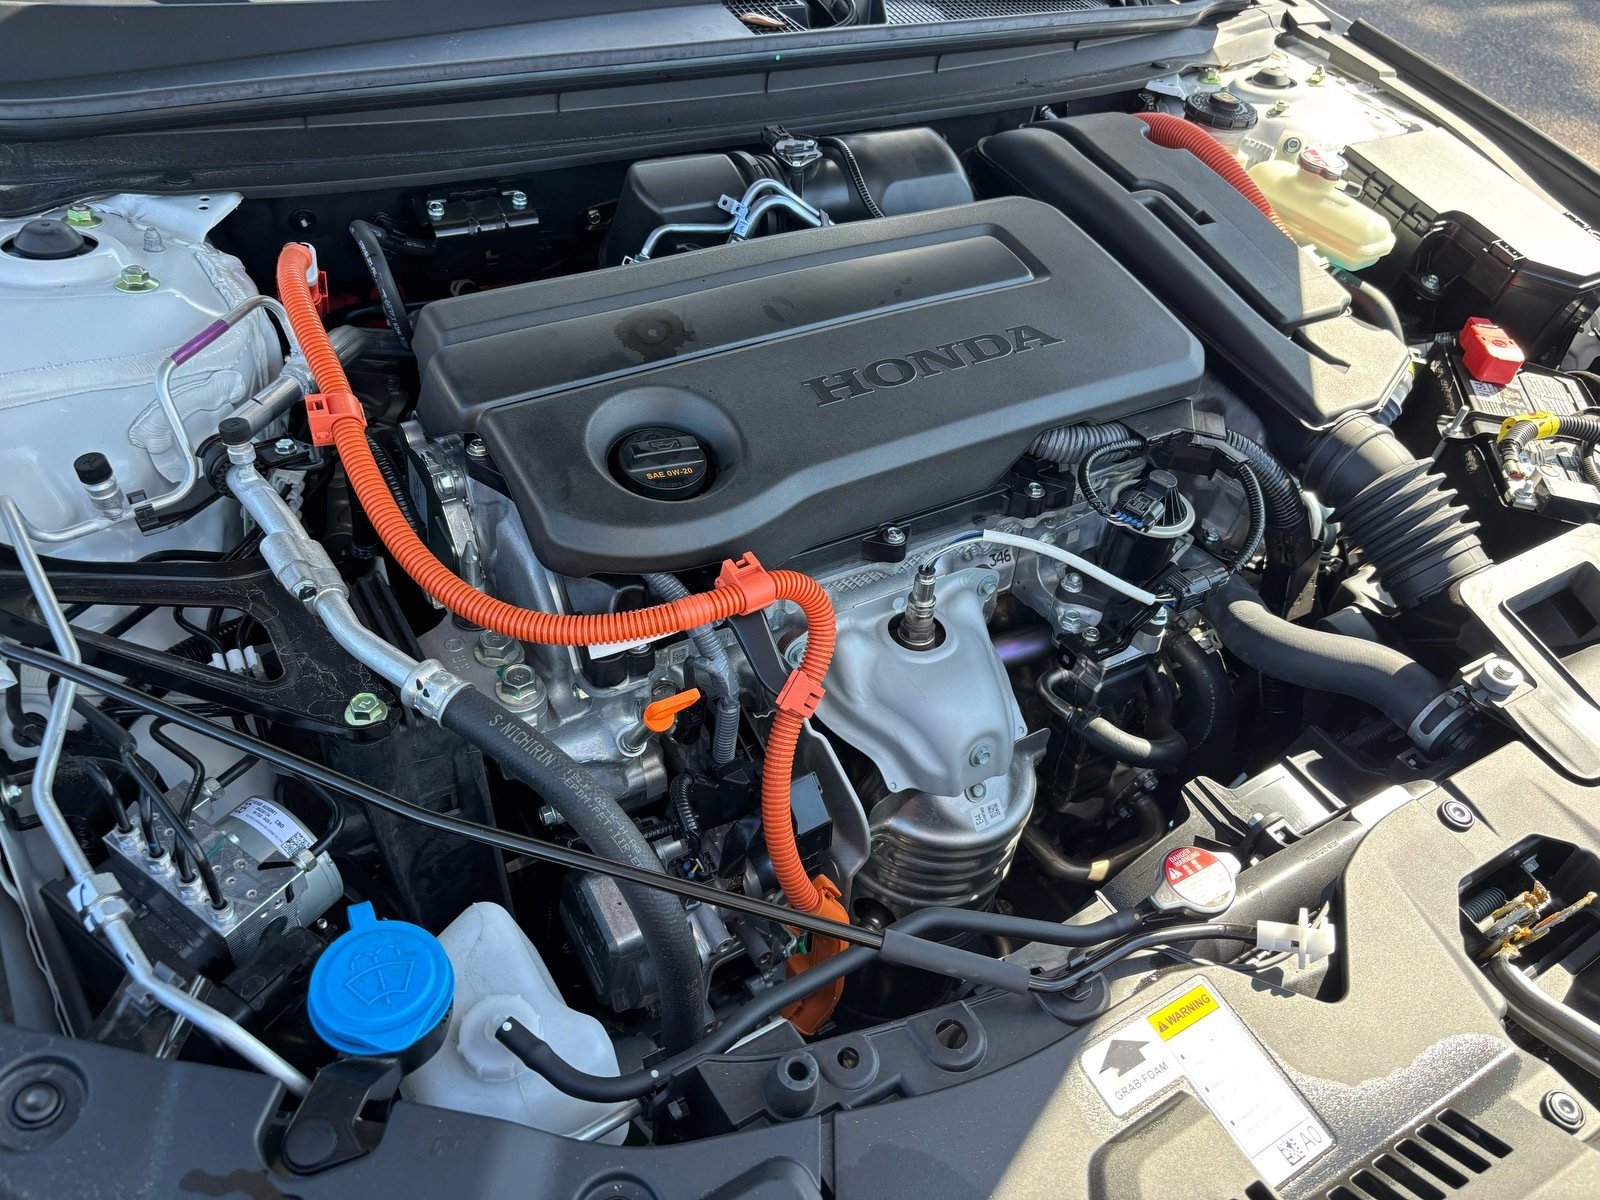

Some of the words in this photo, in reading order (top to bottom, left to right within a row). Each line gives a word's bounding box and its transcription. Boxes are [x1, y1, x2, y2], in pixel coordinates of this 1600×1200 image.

[801, 324, 1066, 408] HONDA
[646, 471, 666, 480] SAE
[666, 467, 693, 477] 0W-20
[989, 549, 1012, 567] 346
[1168, 847, 1191, 862] DANGER
[1174, 850, 1201, 867] WARNING
[1165, 993, 1211, 1026] WARNING
[1114, 1078, 1142, 1101] GRAB
[1141, 1061, 1169, 1083] FOAM
